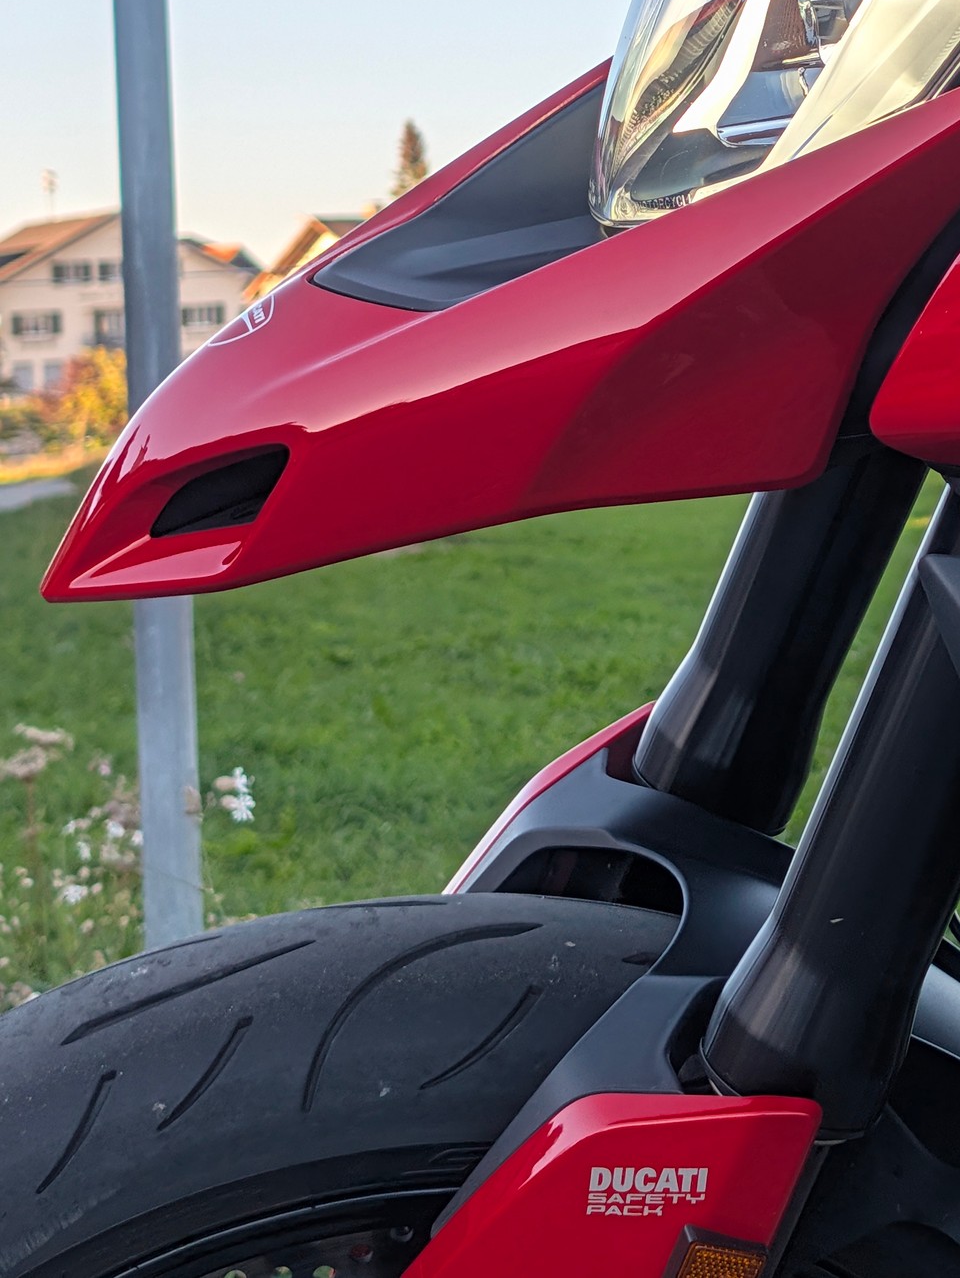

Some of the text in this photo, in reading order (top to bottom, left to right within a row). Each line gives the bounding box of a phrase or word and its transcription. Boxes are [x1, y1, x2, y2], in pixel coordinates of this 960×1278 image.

[588, 1167, 709, 1192] DUCATI
[588, 1193, 706, 1204] SAFETY
[586, 1205, 664, 1216] PACK
